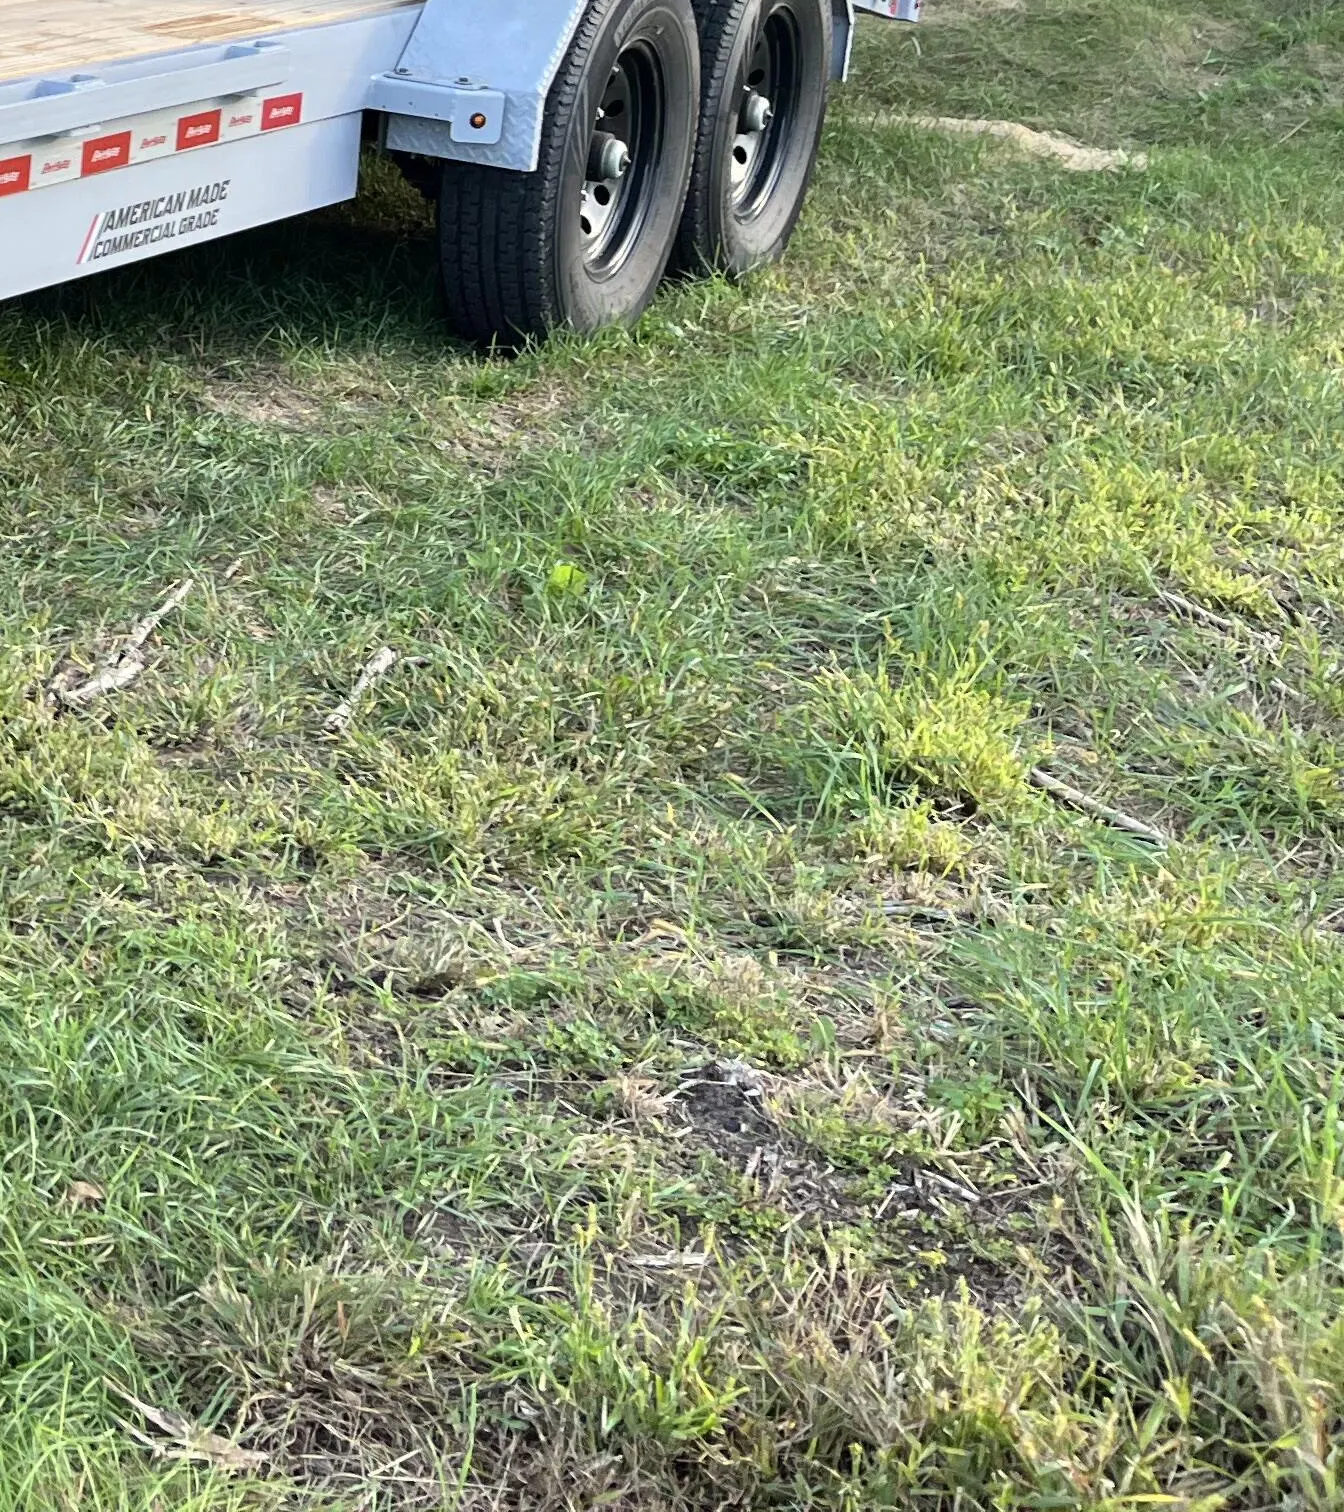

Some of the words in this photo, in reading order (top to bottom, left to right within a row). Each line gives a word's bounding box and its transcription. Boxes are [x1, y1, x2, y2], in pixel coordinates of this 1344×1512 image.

[103, 191, 186, 232] AMERICAN
[186, 179, 231, 210] MADE
[93, 221, 176, 259] COMMERCIAL
[178, 208, 220, 235] GRADE
